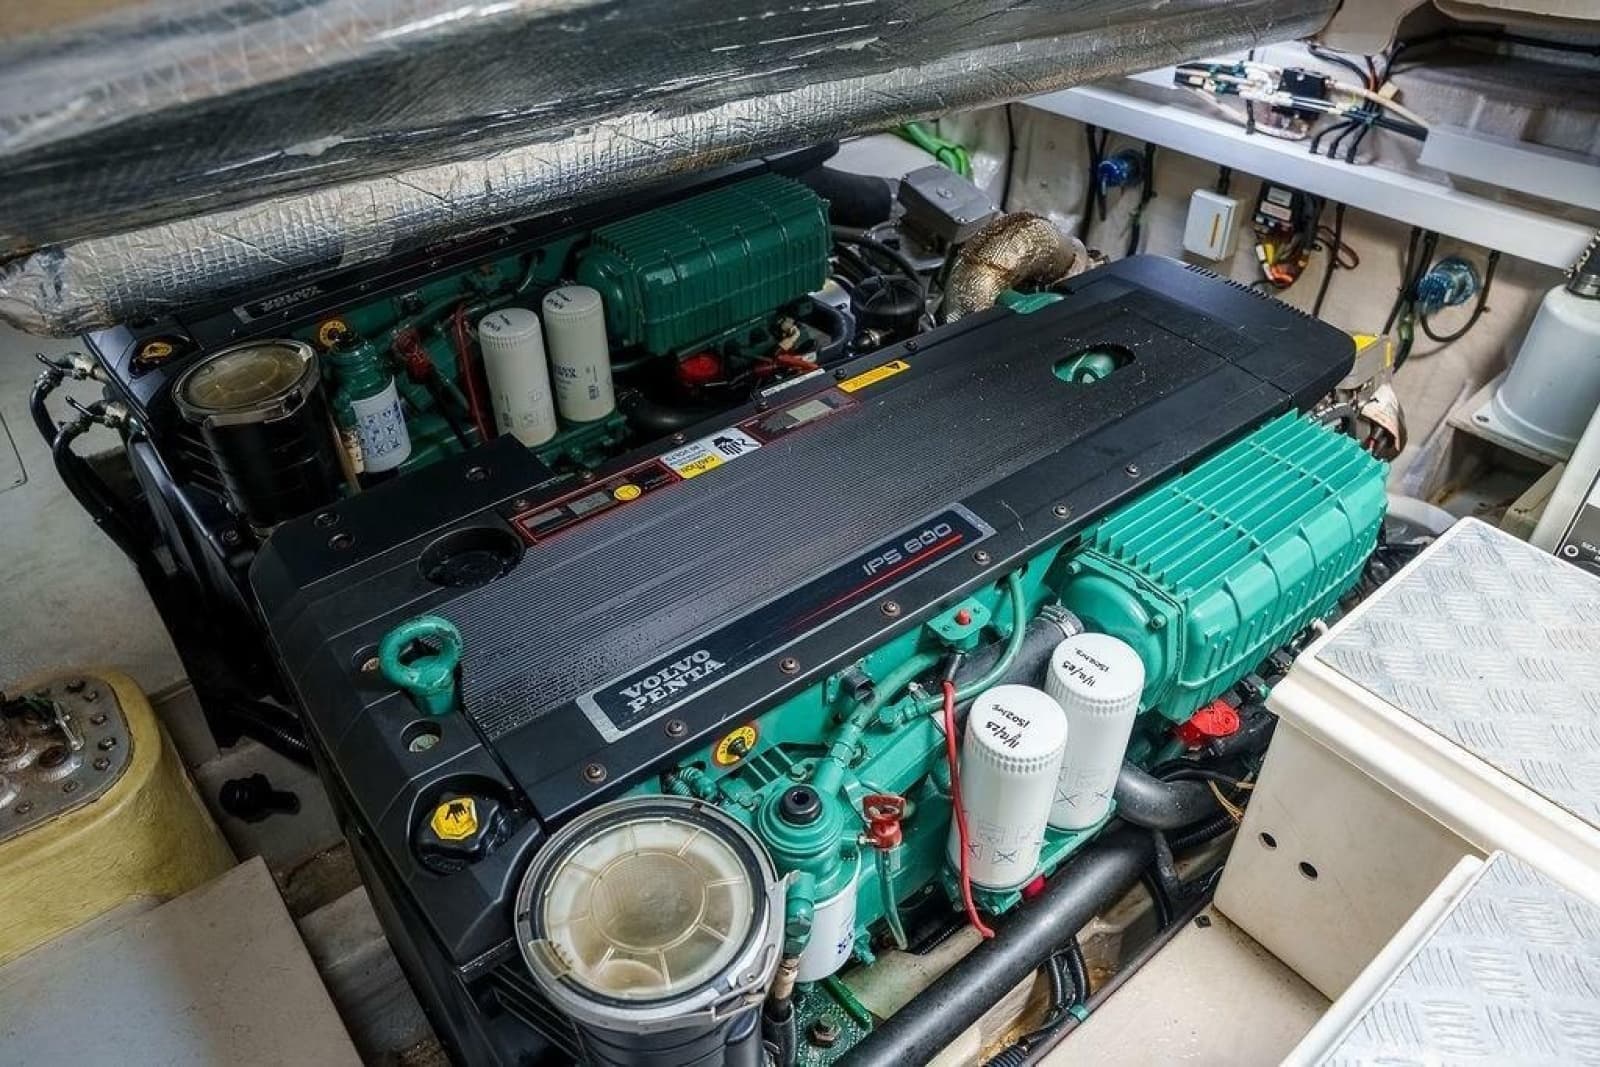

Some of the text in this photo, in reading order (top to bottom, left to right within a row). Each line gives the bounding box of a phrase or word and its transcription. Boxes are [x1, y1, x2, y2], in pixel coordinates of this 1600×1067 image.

[862, 548, 902, 576] IPS
[619, 649, 711, 698] VOLVO
[627, 659, 726, 713] PENTA
